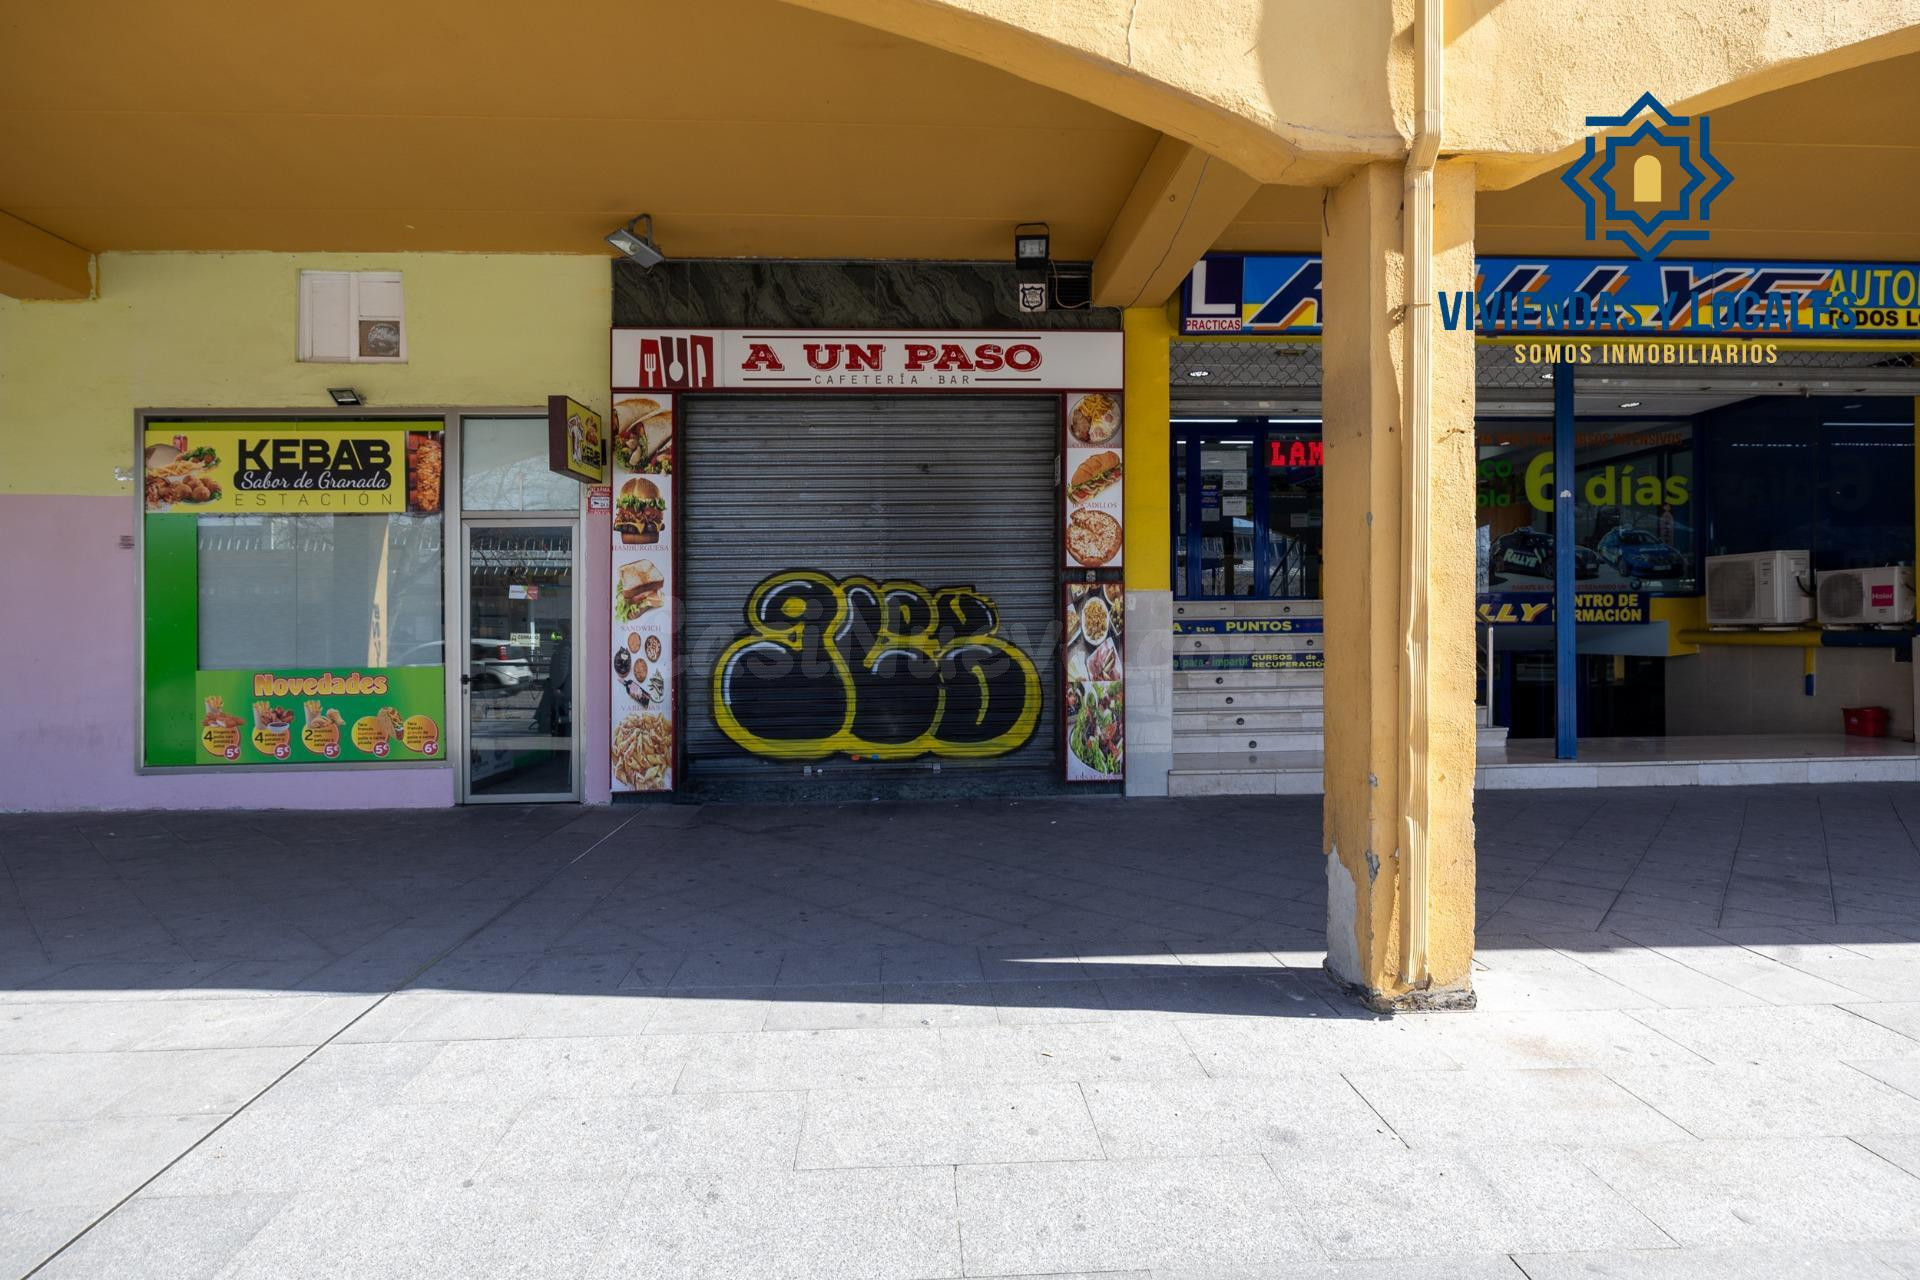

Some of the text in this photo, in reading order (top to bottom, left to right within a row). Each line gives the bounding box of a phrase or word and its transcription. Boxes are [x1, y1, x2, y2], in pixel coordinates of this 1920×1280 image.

[1829, 269, 1920, 306] AUTO
[1186, 319, 1241, 330] PRACTICAS
[742, 343, 1043, 372] A UN PASO
[814, 373, 971, 385] CAFETERÍA BAR
[238, 439, 392, 471] KEBAB
[241, 470, 389, 490] Sabor de Granada
[1584, 465, 1689, 506] días
[234, 491, 392, 506] ESTACIÓN
[1618, 594, 1639, 607] DE
[1225, 621, 1292, 632] PUNTOS
[254, 673, 389, 698] Novedades
[203, 730, 213, 742] 4
[254, 732, 264, 743] 4
[304, 729, 313, 741] 2
